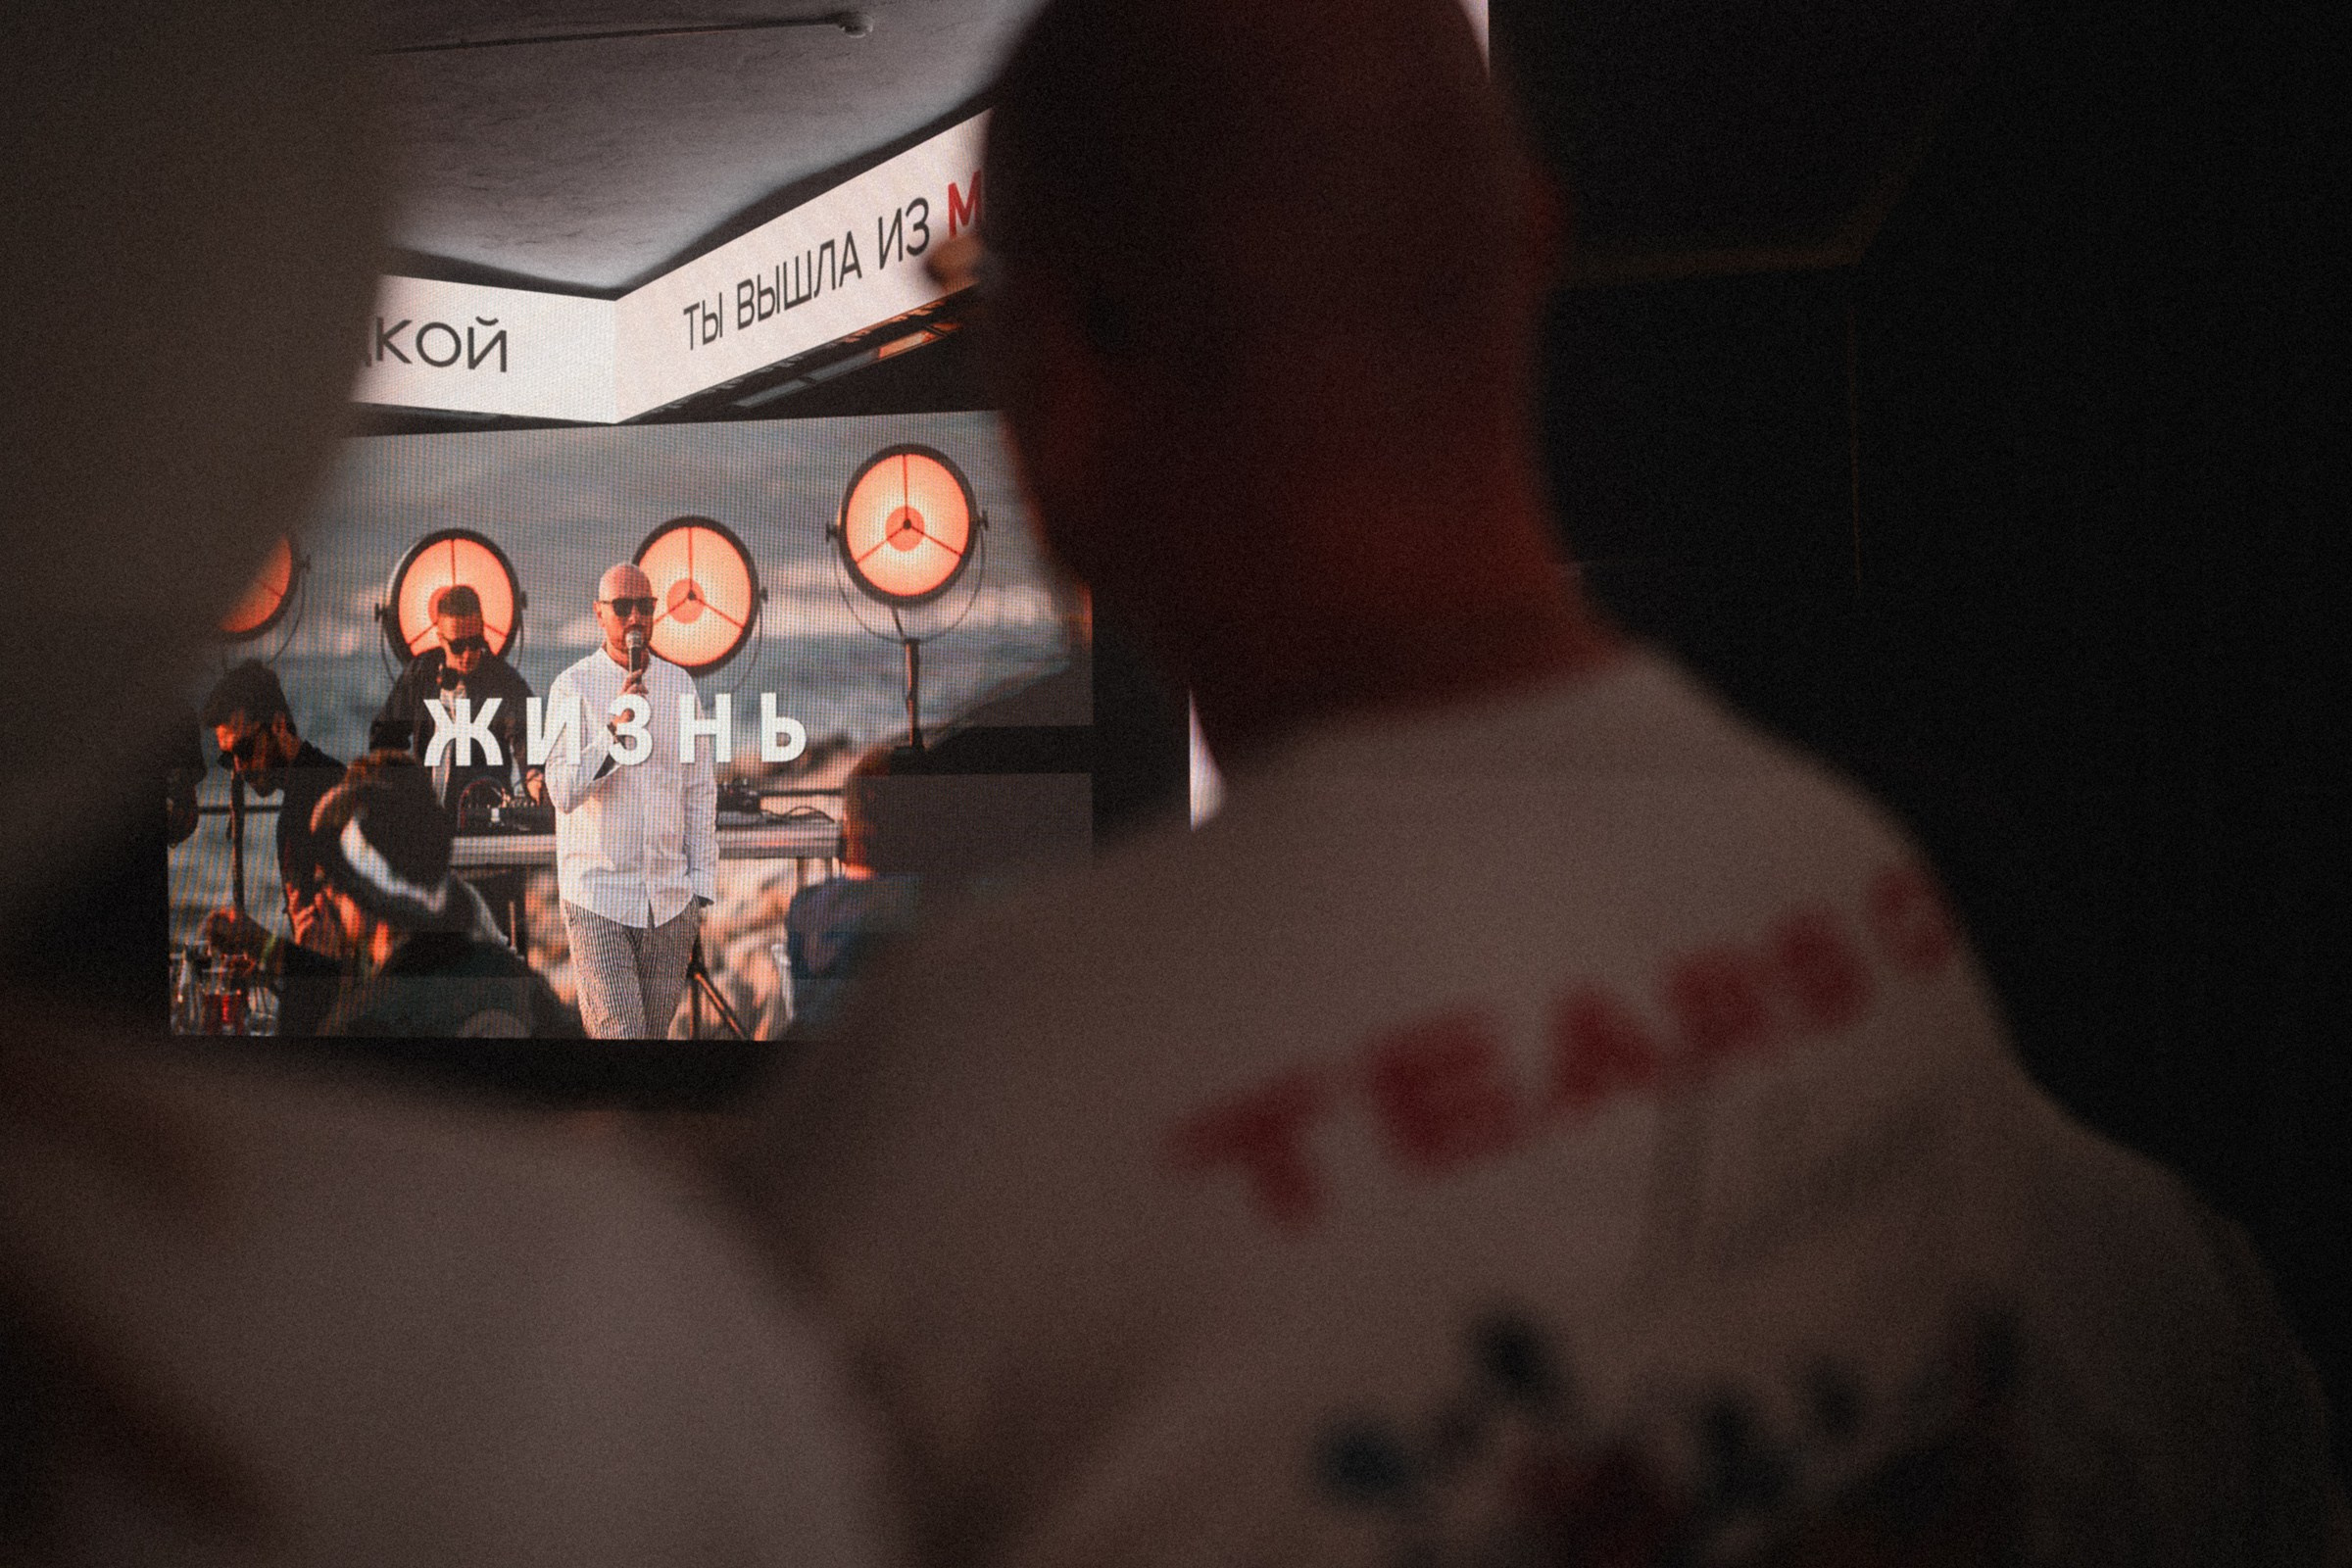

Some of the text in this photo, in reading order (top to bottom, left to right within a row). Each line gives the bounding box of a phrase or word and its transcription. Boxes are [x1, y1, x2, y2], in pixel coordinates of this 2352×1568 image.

[683, 292, 724, 351] ТЫ
[737, 230, 862, 331] ВЫШЛА
[878, 197, 931, 270] ИЗ
[365, 316, 508, 373] КОЙ
[423, 691, 808, 768] ЖИЗНЬ
